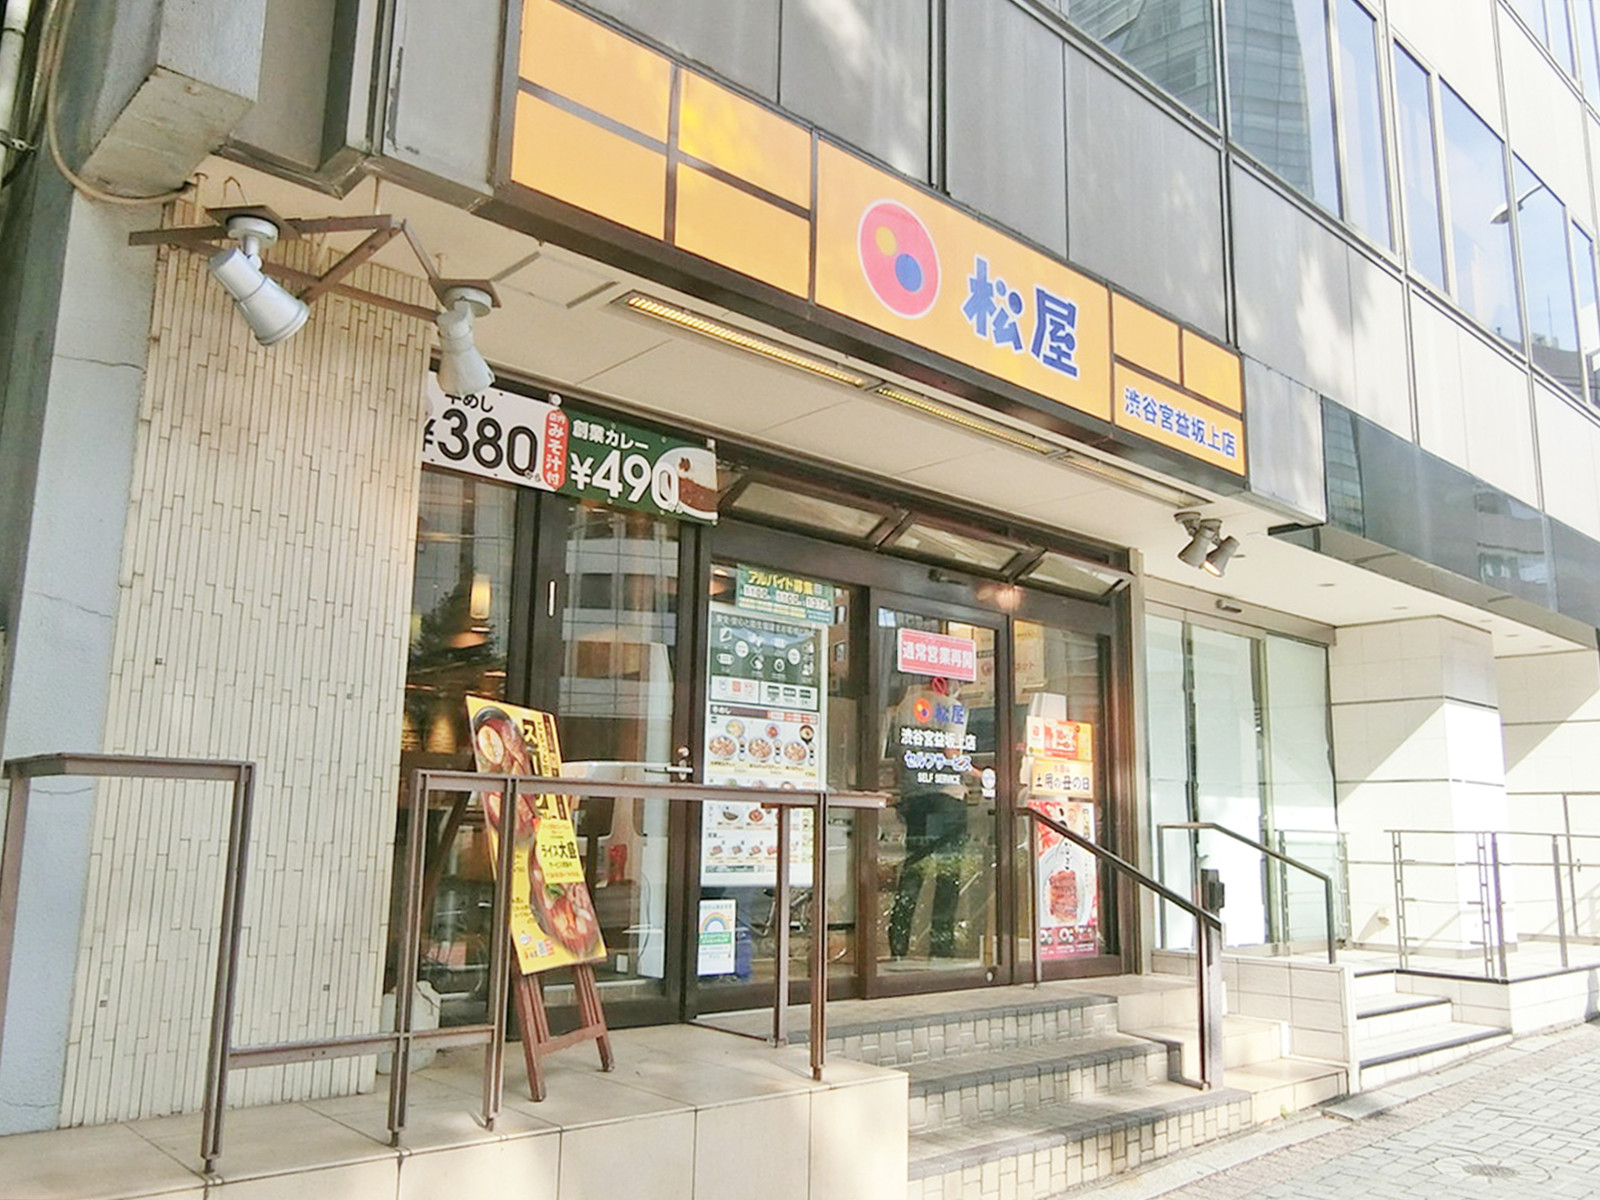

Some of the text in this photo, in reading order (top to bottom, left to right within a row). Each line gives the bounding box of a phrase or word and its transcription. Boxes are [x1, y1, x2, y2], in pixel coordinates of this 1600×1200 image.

[960, 255, 1078, 378] 松屋
[1125, 387, 1235, 458] 渋谷宮益坂上店
[572, 419, 649, 450] 創業カレー
[570, 449, 680, 511] ¥490
[935, 703, 965, 725] 松屋
[901, 727, 976, 751] 渋谷宮益坂上店
[904, 750, 973, 772] セルフサービス
[917, 771, 961, 785] SELF SERVICE
[1035, 772, 1090, 791] 土用の丑の日
[541, 840, 578, 859] ライス大盛
